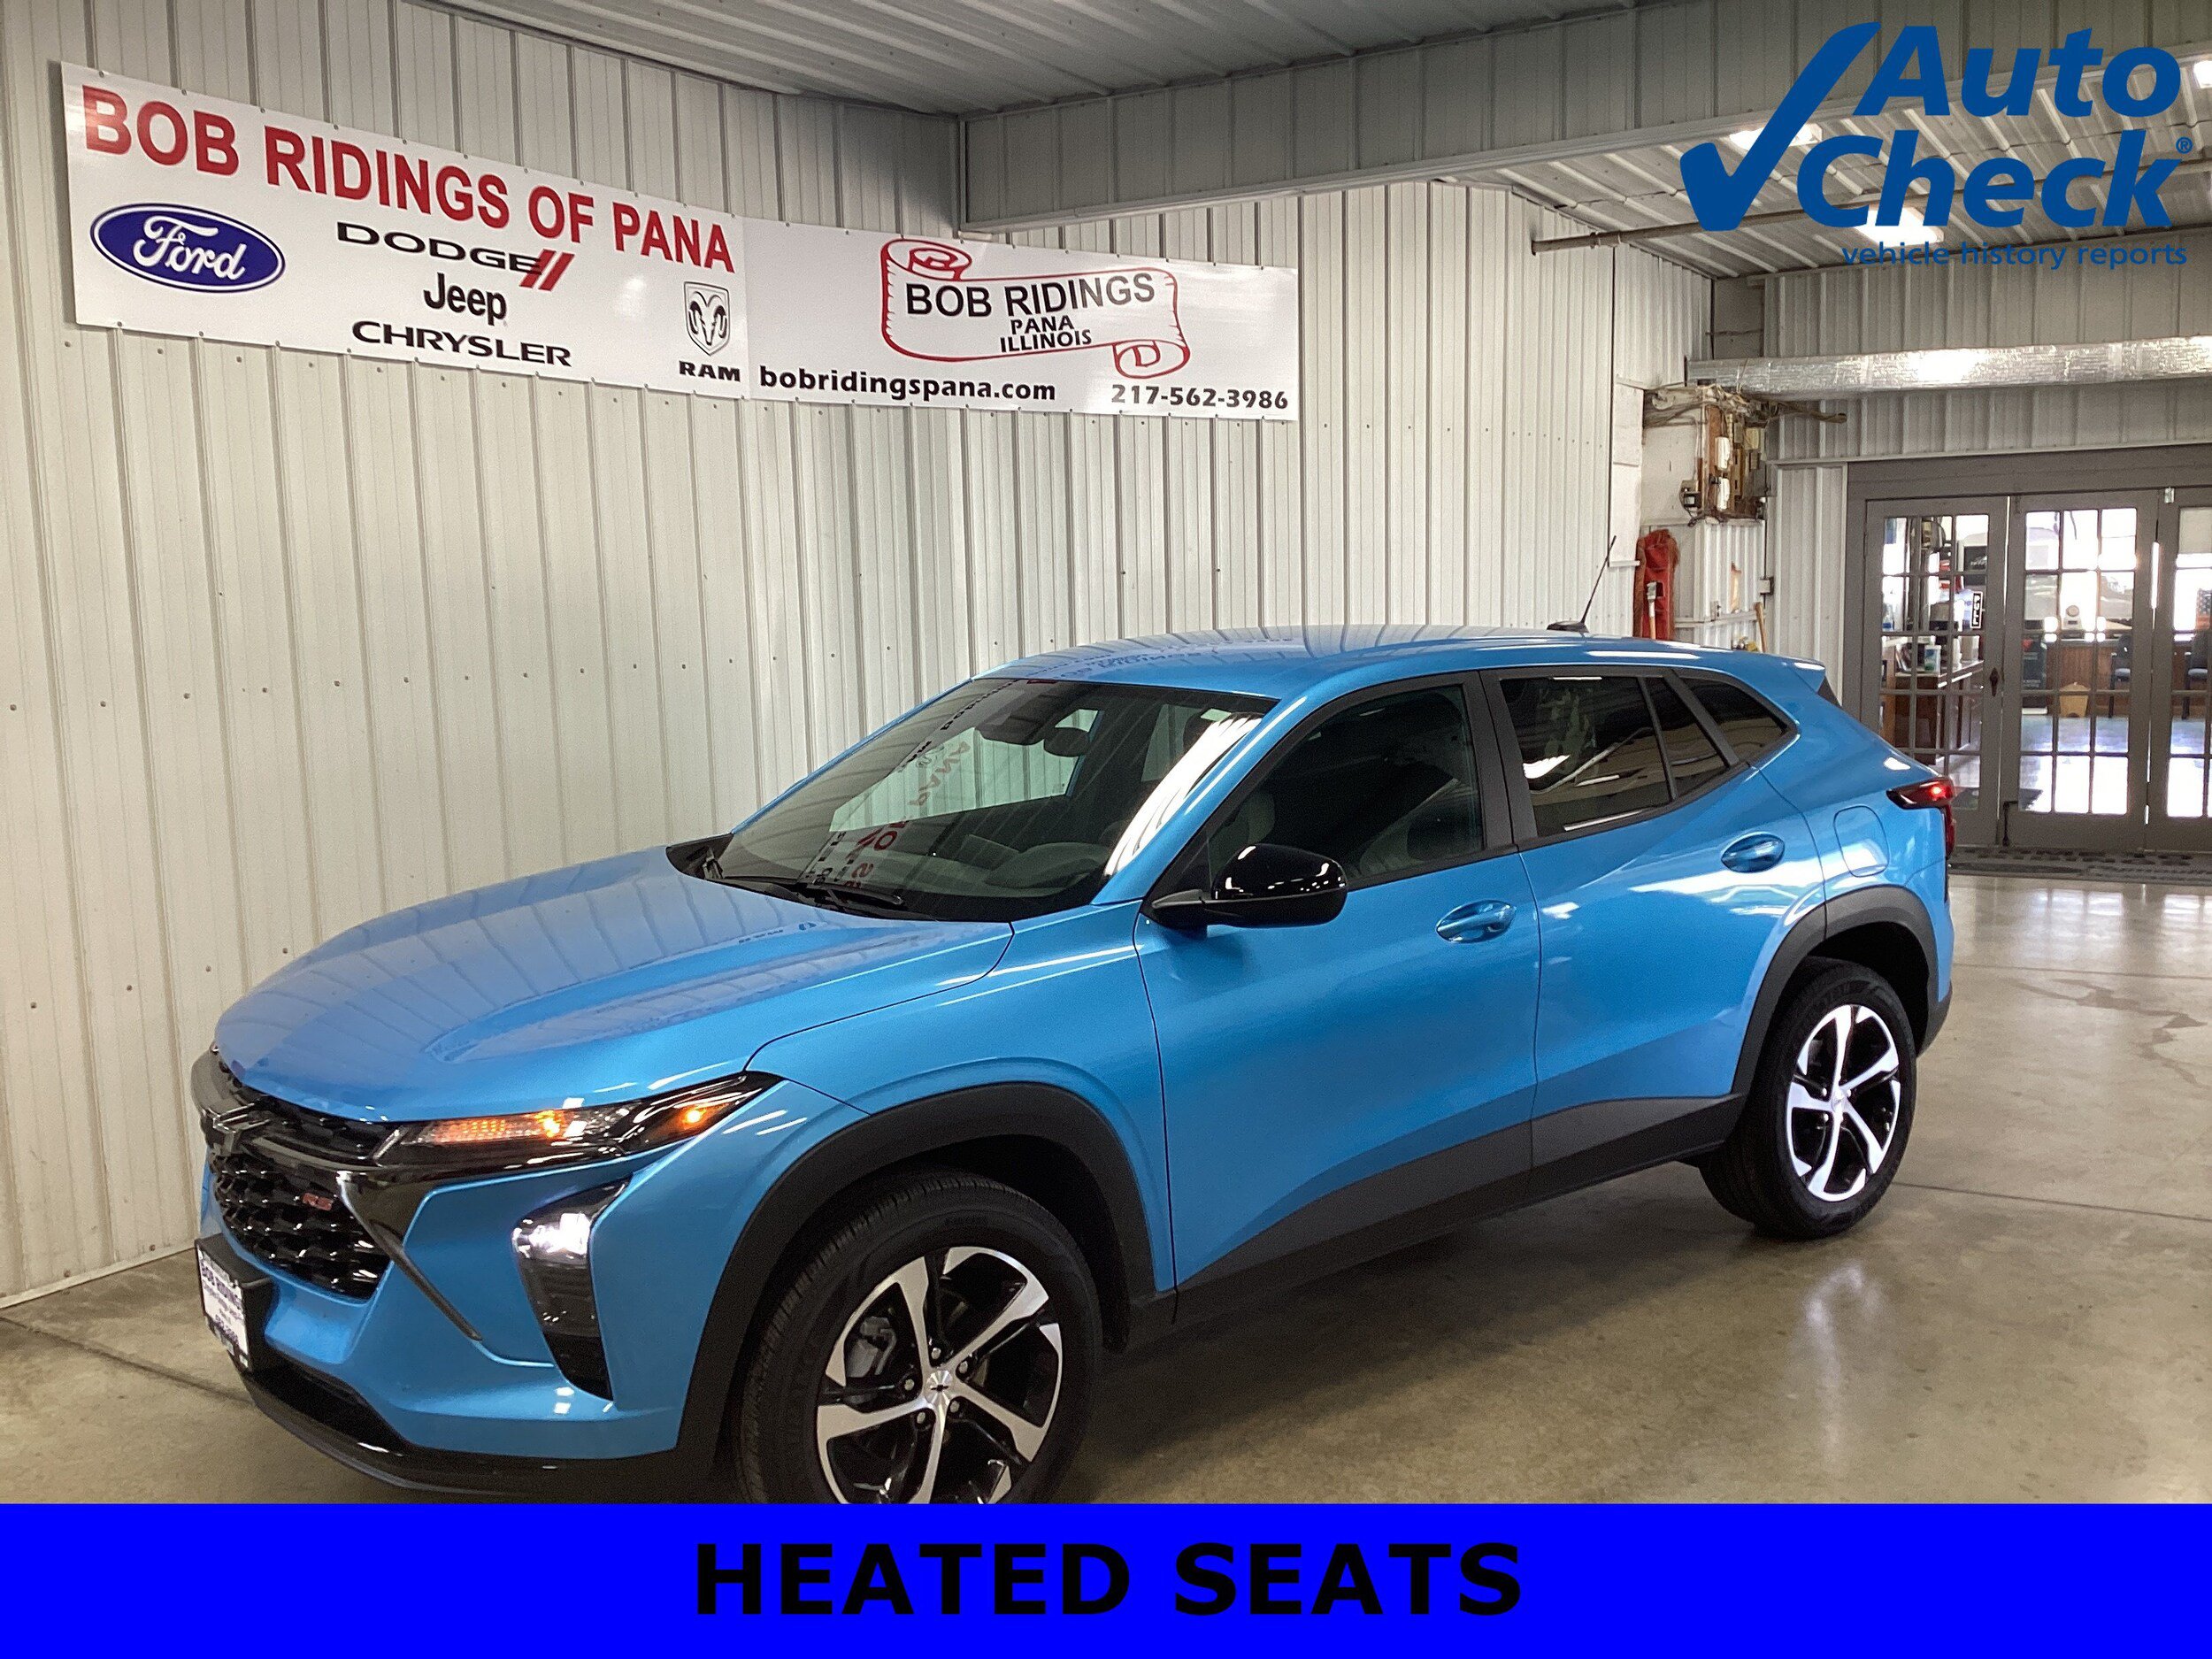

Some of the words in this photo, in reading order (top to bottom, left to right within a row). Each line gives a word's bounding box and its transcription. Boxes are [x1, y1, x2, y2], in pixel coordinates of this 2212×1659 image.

[82, 84, 240, 176] BOB
[265, 126, 510, 229] RIDINGS
[528, 186, 595, 243] OF
[612, 201, 735, 273] PANA
[133, 213, 248, 280] Ford
[337, 221, 542, 273] DODGE
[424, 273, 507, 323] Jeep
[906, 282, 992, 318] BOB
[1006, 273, 1156, 316] RIDINGS
[352, 321, 572, 367] CHRYSLER
[1000, 328, 1093, 353] ILLINOIS
[1010, 314, 1075, 336] PANA
[679, 360, 741, 382] RAM
[759, 365, 1056, 401] bobridingspana.com
[1111, 384, 1289, 410] 217-562-3986
